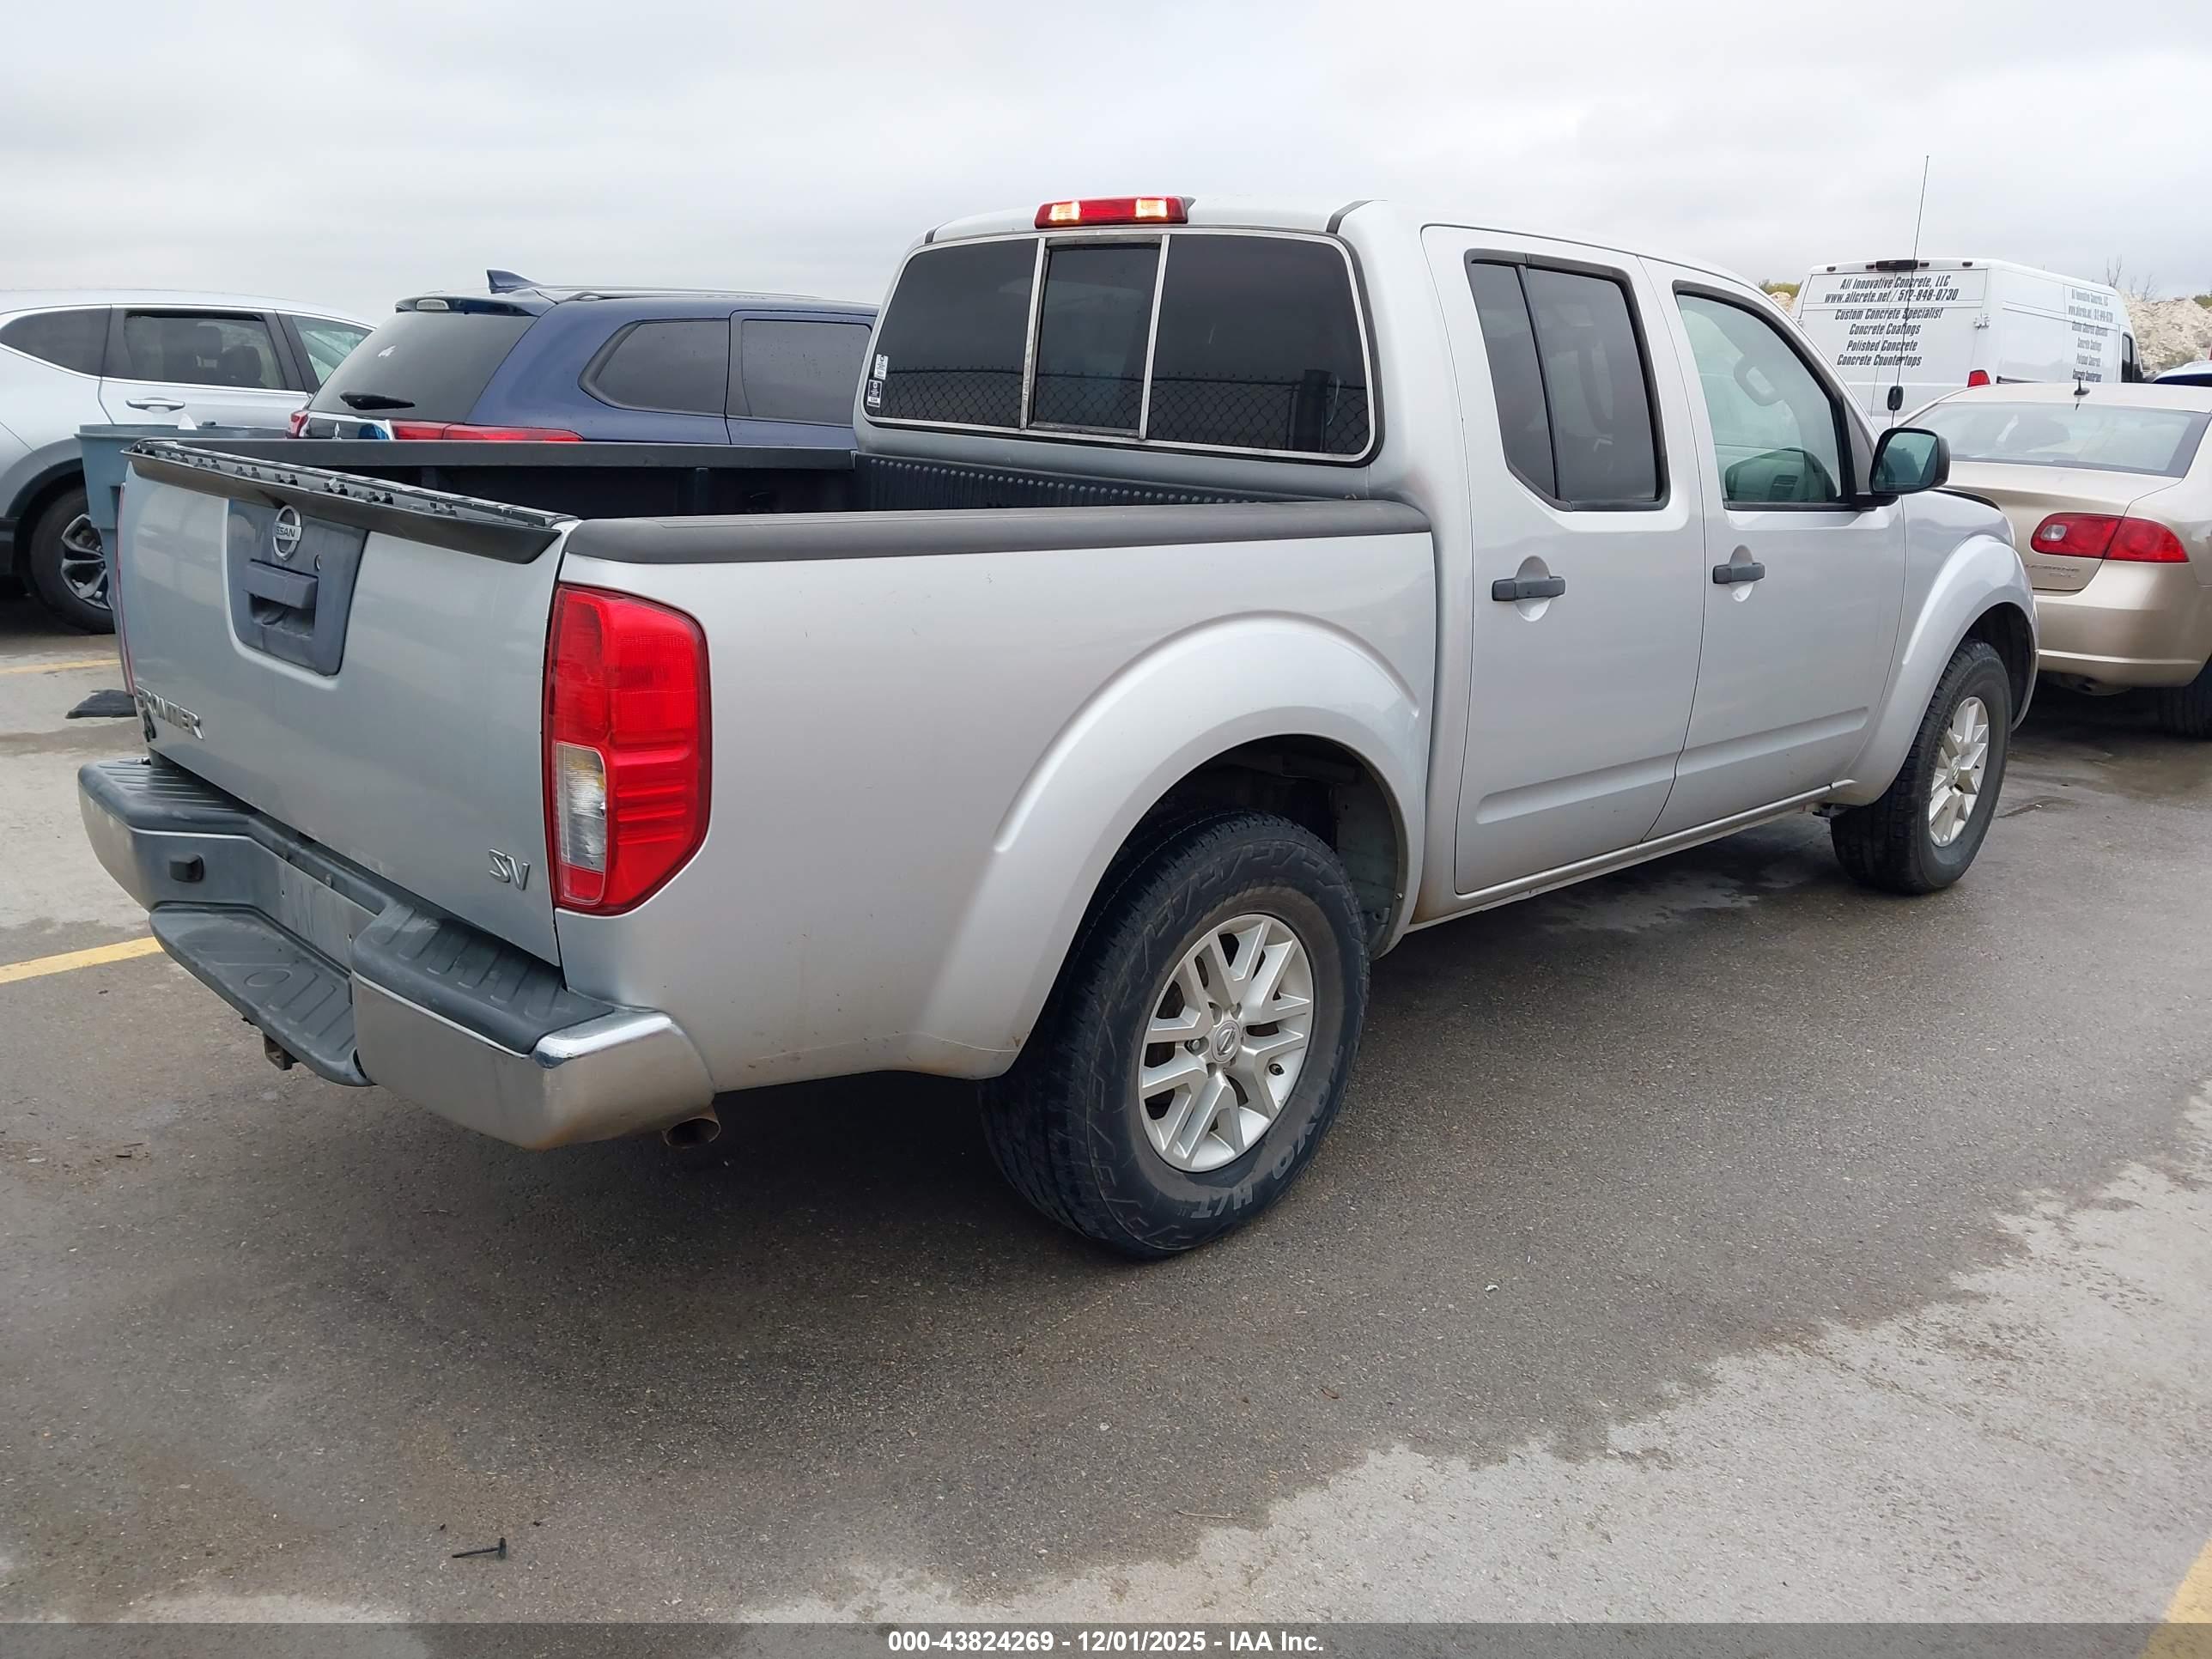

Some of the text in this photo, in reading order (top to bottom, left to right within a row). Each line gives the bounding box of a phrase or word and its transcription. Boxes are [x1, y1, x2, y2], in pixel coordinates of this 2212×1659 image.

[1839, 275, 1952, 289] All Innovative Concrete, LLC
[1825, 290, 1891, 303] www.allcrete.net
[1898, 289, 1960, 302] 512-848-0730
[1834, 307, 1944, 320] Custom Concrete Specialist
[1849, 323, 1922, 337] Concrete Coatings
[1846, 339, 1918, 352] Polished Concrete
[1837, 354, 1923, 368] Concrete Countertops
[488, 848, 531, 890] SV
